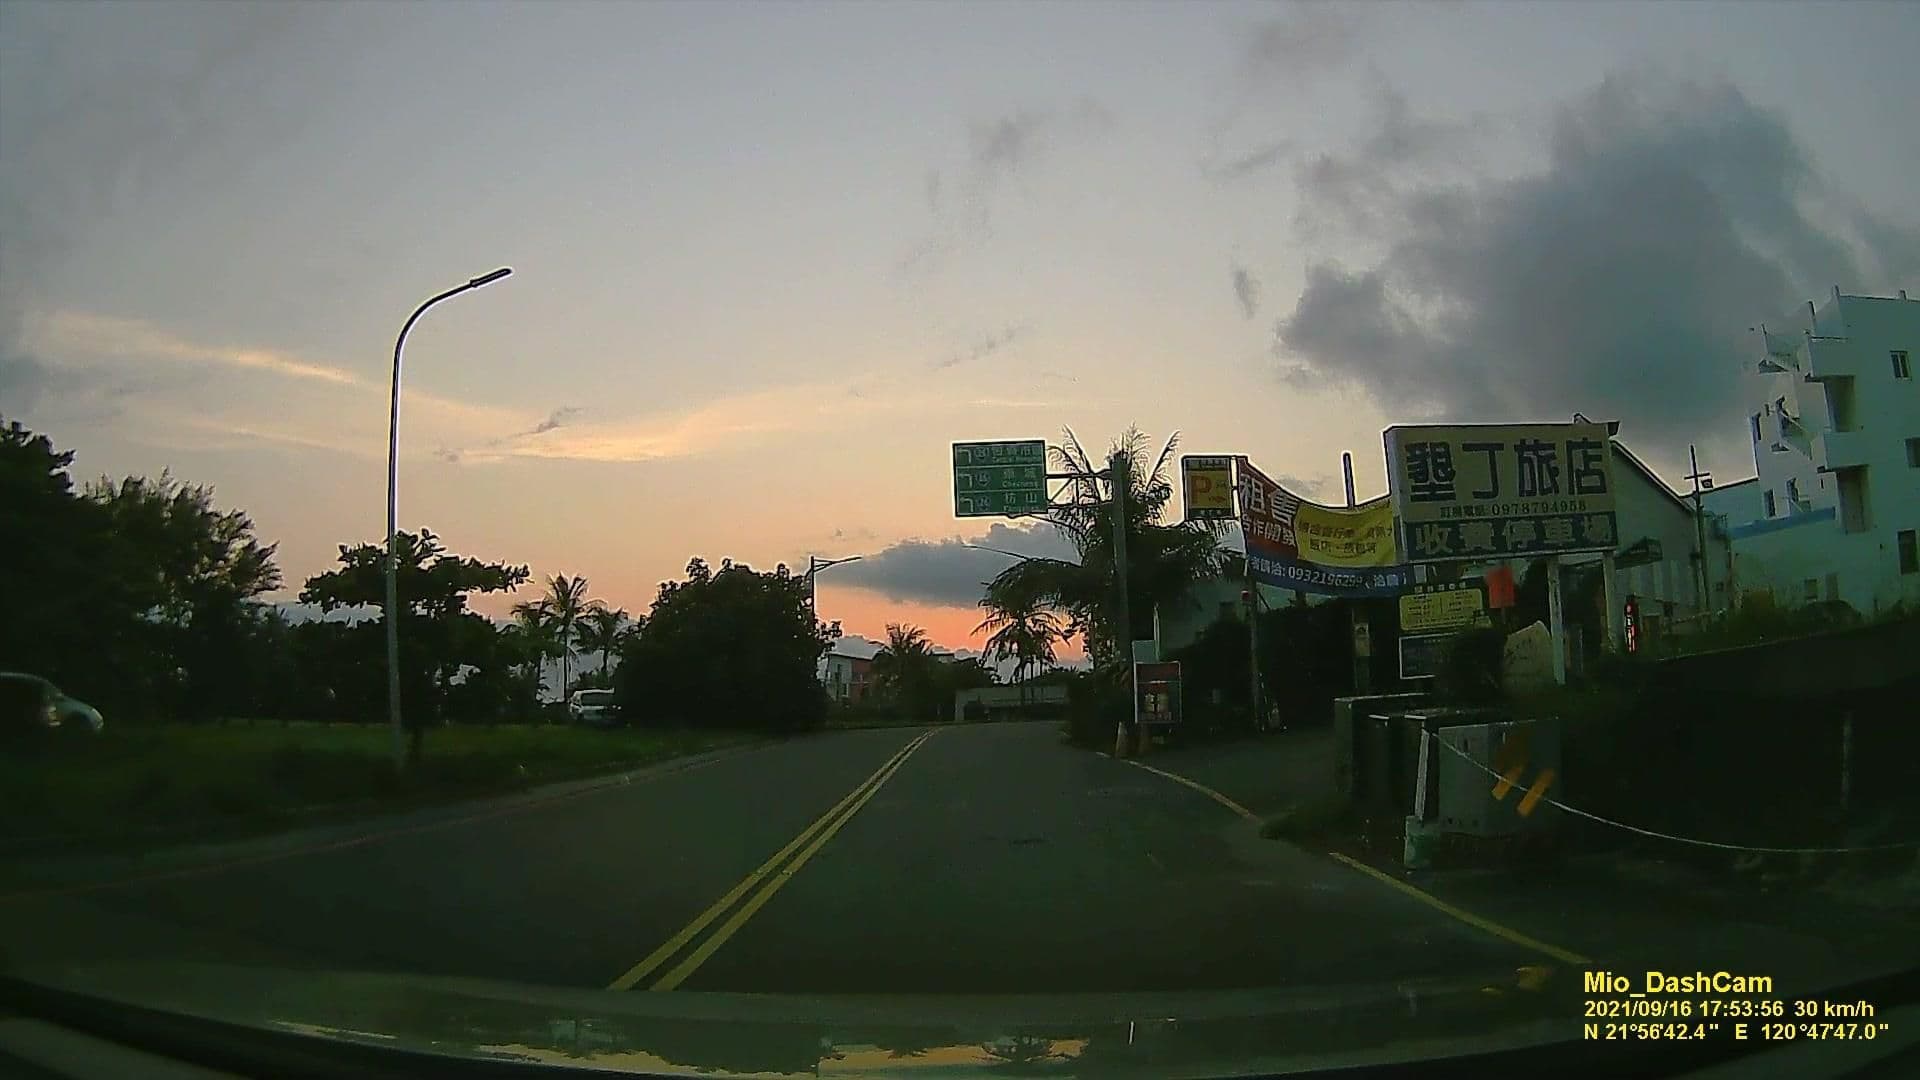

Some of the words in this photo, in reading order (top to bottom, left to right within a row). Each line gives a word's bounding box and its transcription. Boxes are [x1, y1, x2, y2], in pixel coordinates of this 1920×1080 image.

[1191, 475, 1212, 504] P
[1405, 437, 1607, 502] 墾丁旅店
[1240, 473, 1300, 527] 租售
[1415, 514, 1612, 556] 收費停車場
